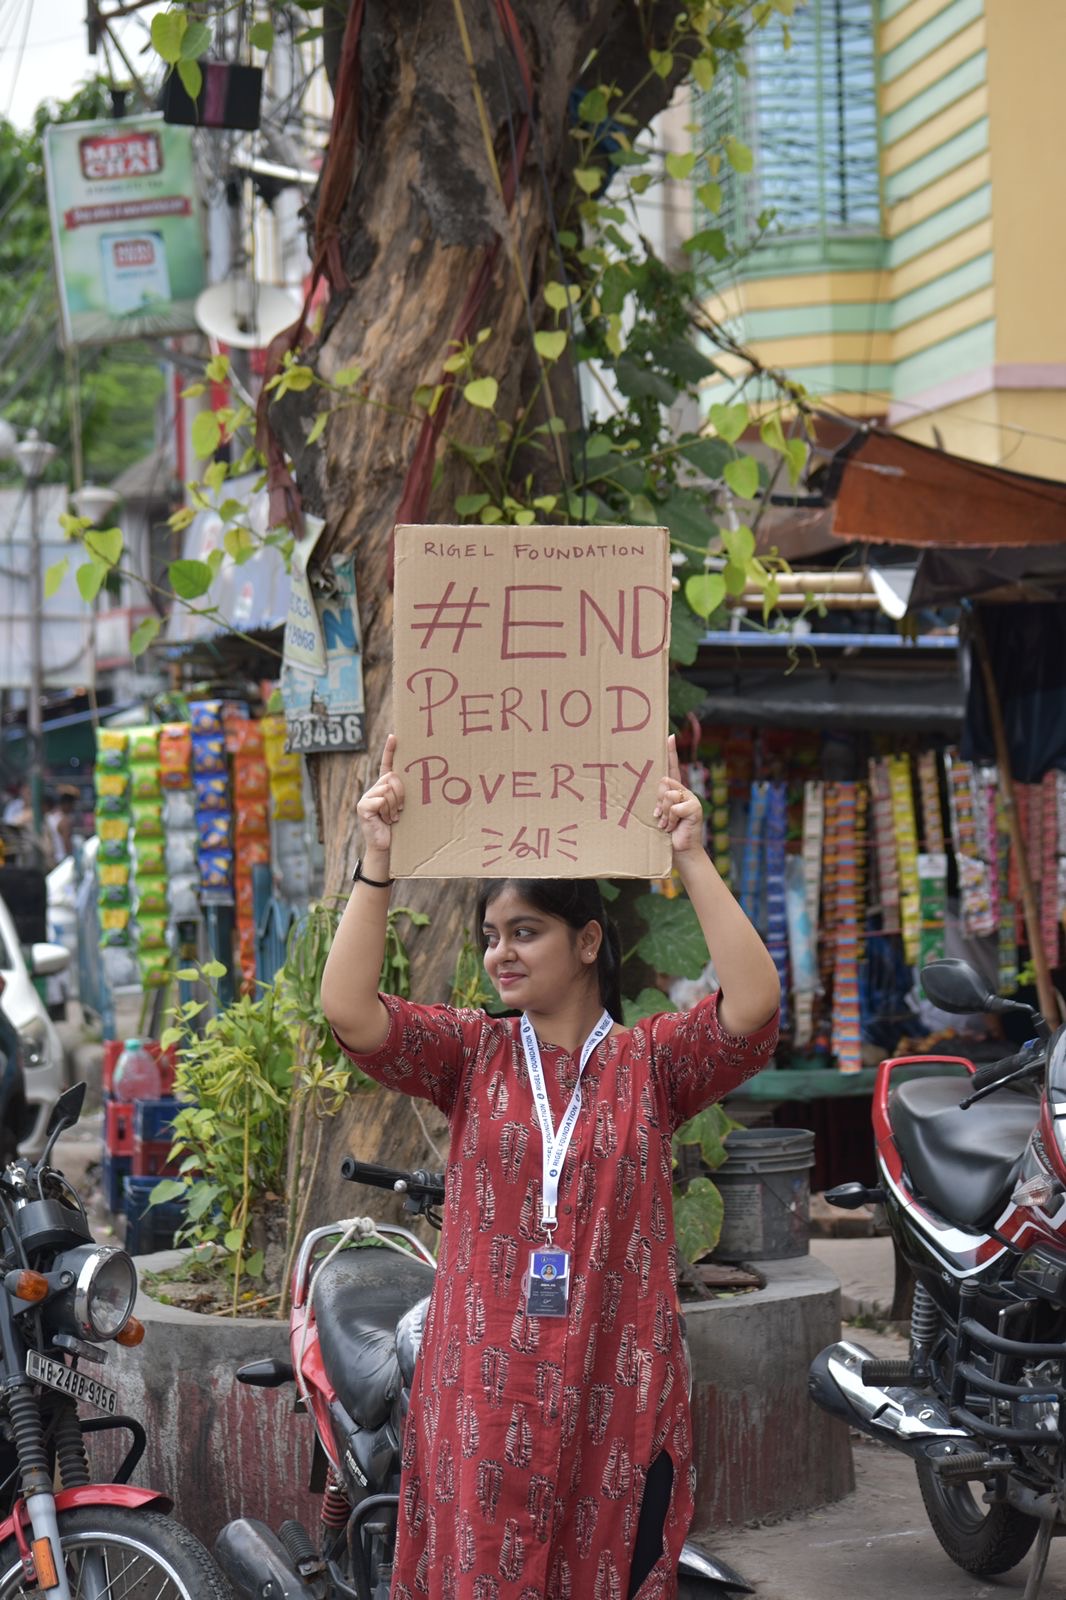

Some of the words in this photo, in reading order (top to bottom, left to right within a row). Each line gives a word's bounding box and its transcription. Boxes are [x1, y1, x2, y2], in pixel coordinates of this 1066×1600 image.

[83, 138, 159, 161] MERI
[85, 156, 160, 178] CHAI
[424, 542, 494, 559] RIGEL
[513, 543, 645, 561] FOUNDATION
[411, 581, 670, 660] #END
[406, 668, 651, 738] PERIOD
[404, 755, 654, 829] POVERTY
[525, 1034, 540, 1073] FOUNDATION
[533, 1073, 543, 1092] RIGEL
[553, 1147, 563, 1167] RIGEL
[559, 1105, 578, 1147] FOUNDATION
[88, 1382, 116, 1412] 9356
